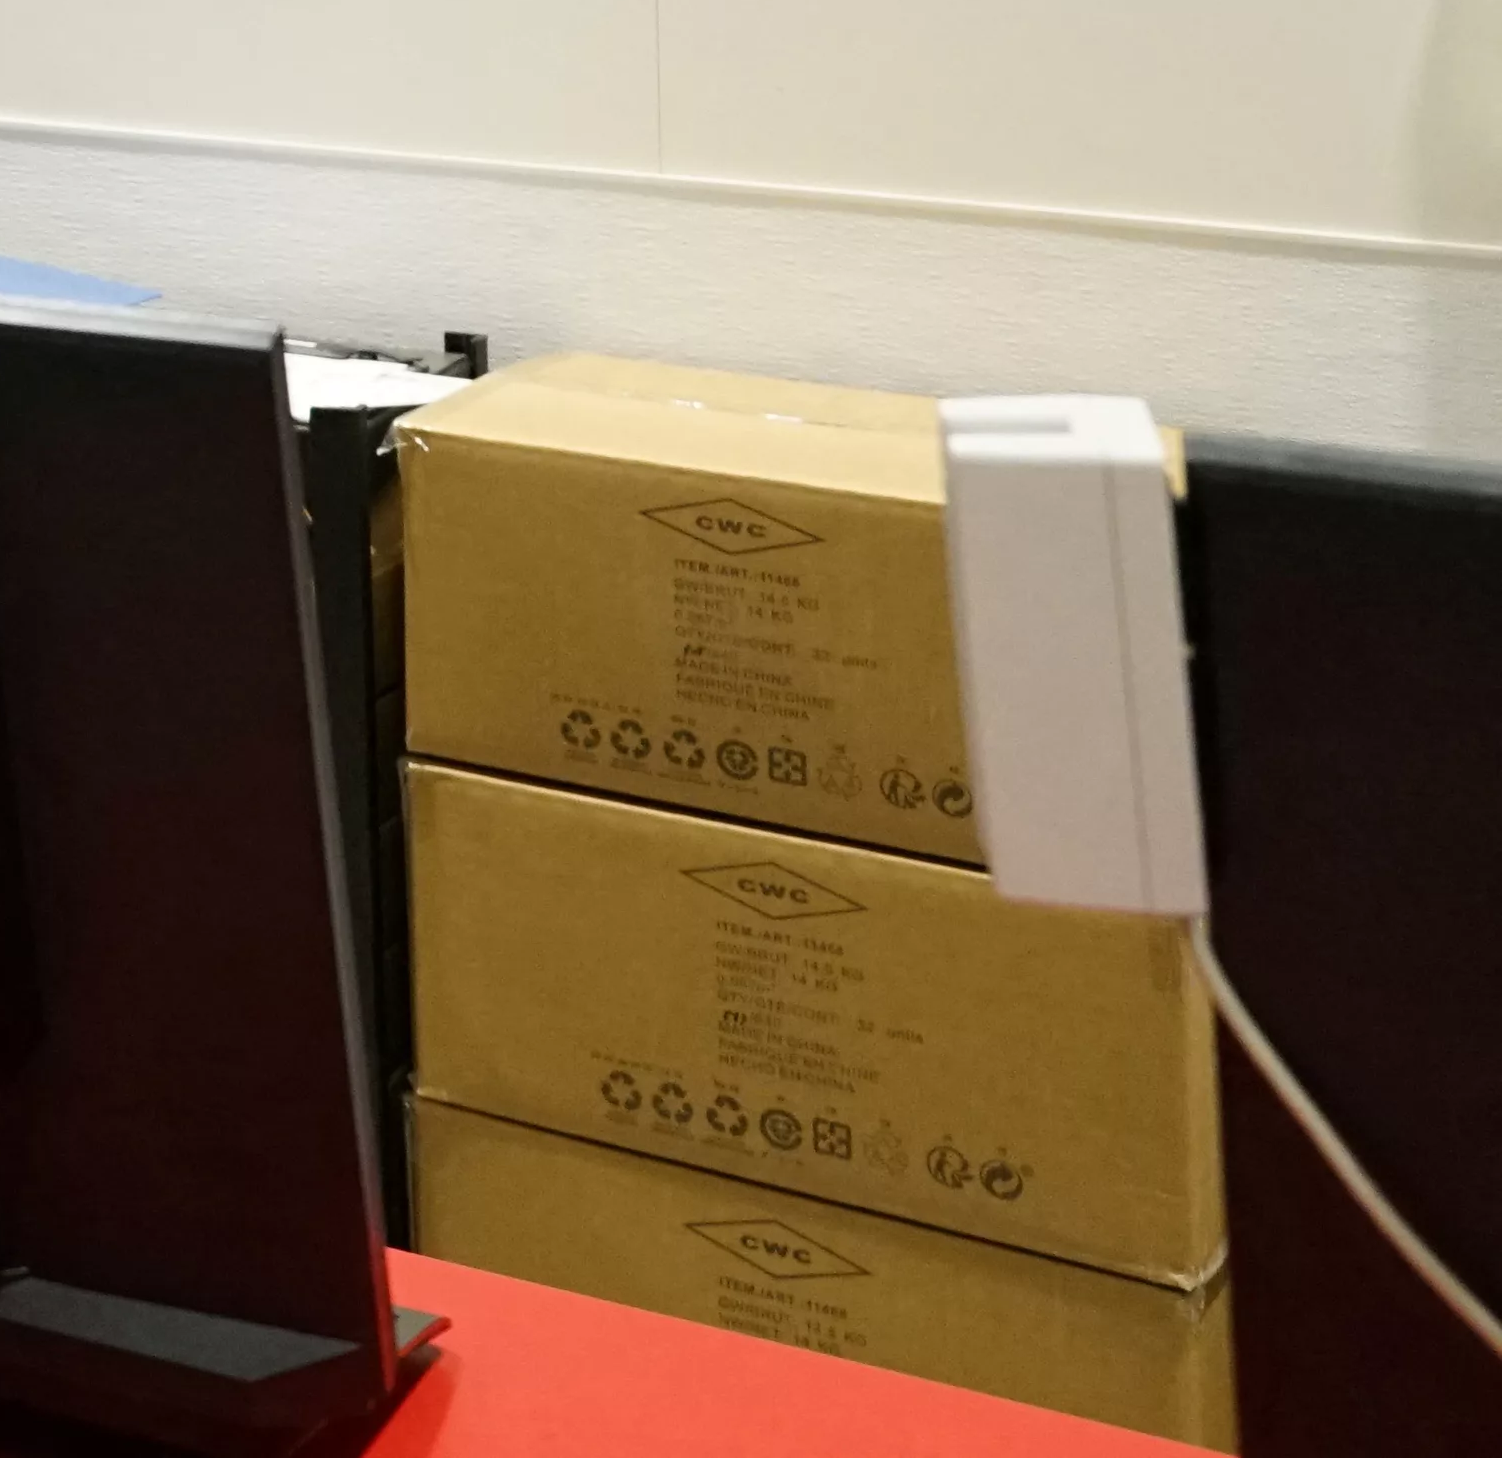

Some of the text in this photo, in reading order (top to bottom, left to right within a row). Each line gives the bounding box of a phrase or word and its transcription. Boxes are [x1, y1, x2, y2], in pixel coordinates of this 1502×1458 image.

[695, 515, 767, 538] CWC
[744, 669, 794, 687] CHINA
[737, 877, 810, 904] CWC
[740, 1234, 812, 1264] CWC
